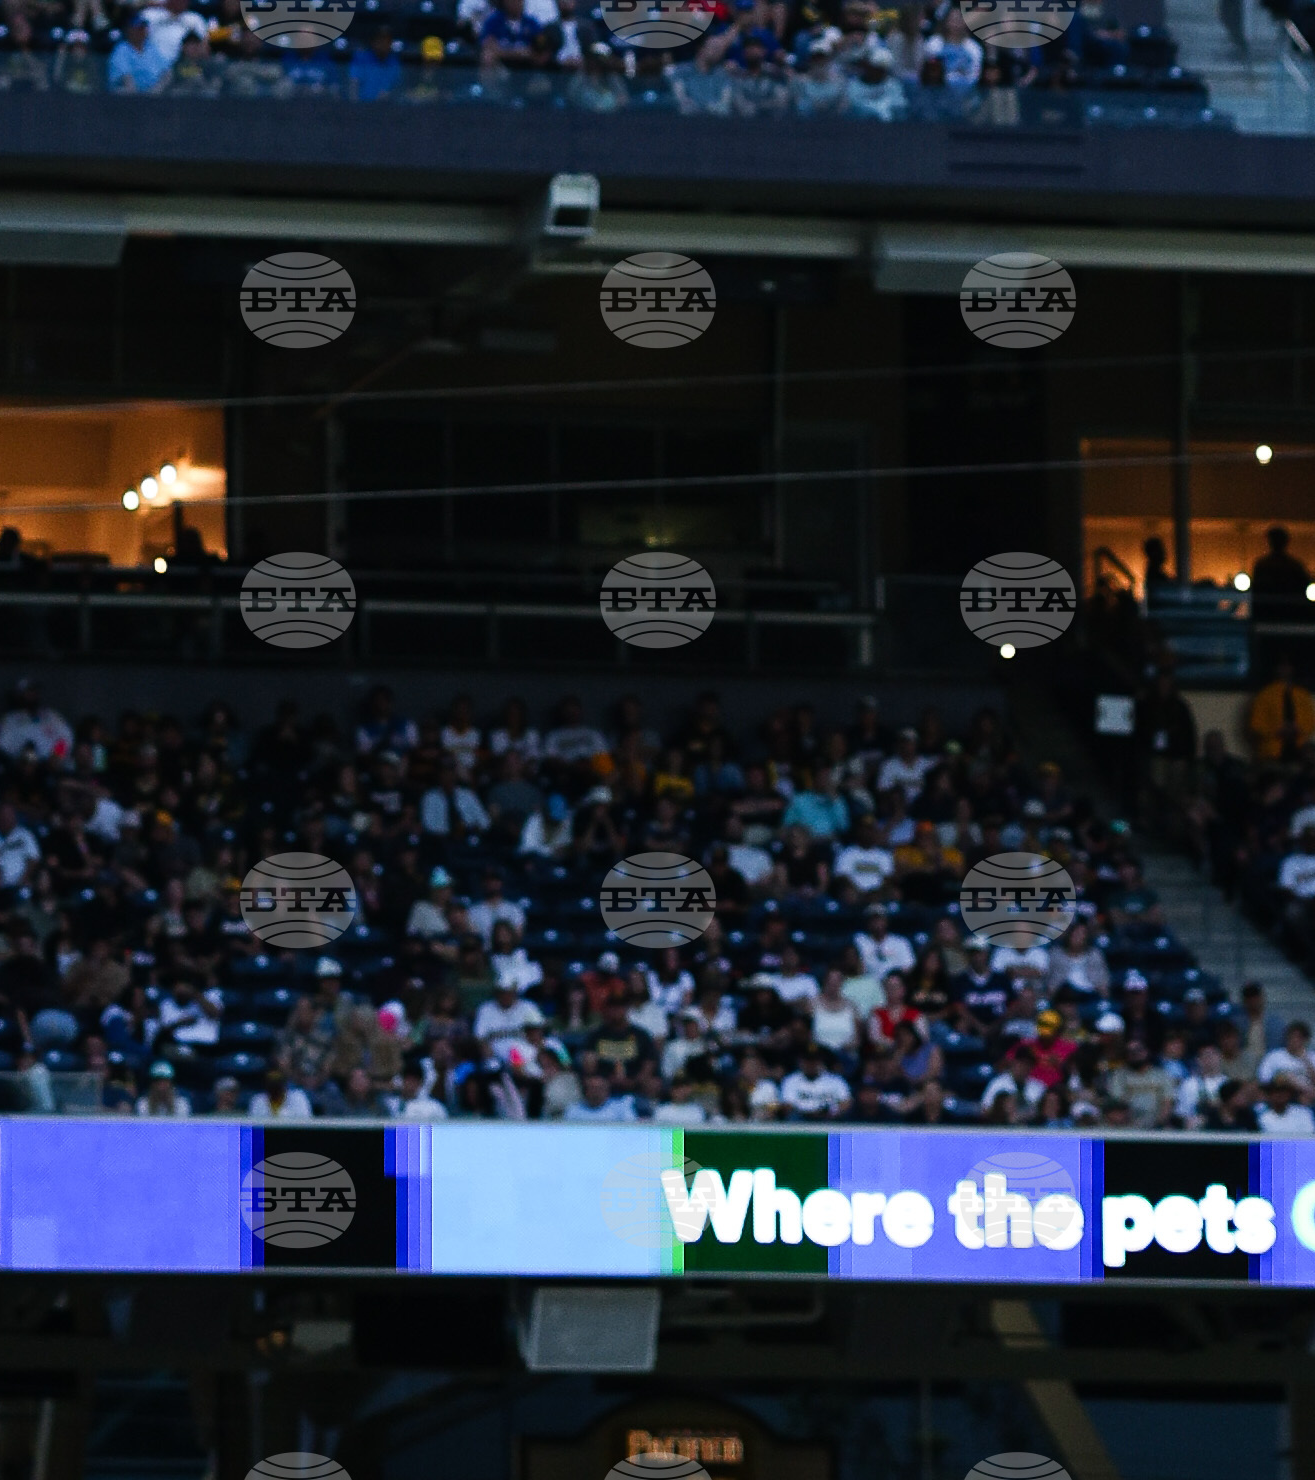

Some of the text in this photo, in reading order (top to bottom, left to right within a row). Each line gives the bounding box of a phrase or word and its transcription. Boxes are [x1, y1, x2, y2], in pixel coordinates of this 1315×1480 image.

[661, 1167, 935, 1248] Where
[947, 1172, 1084, 1250] the
[1102, 1183, 1276, 1267] pets
